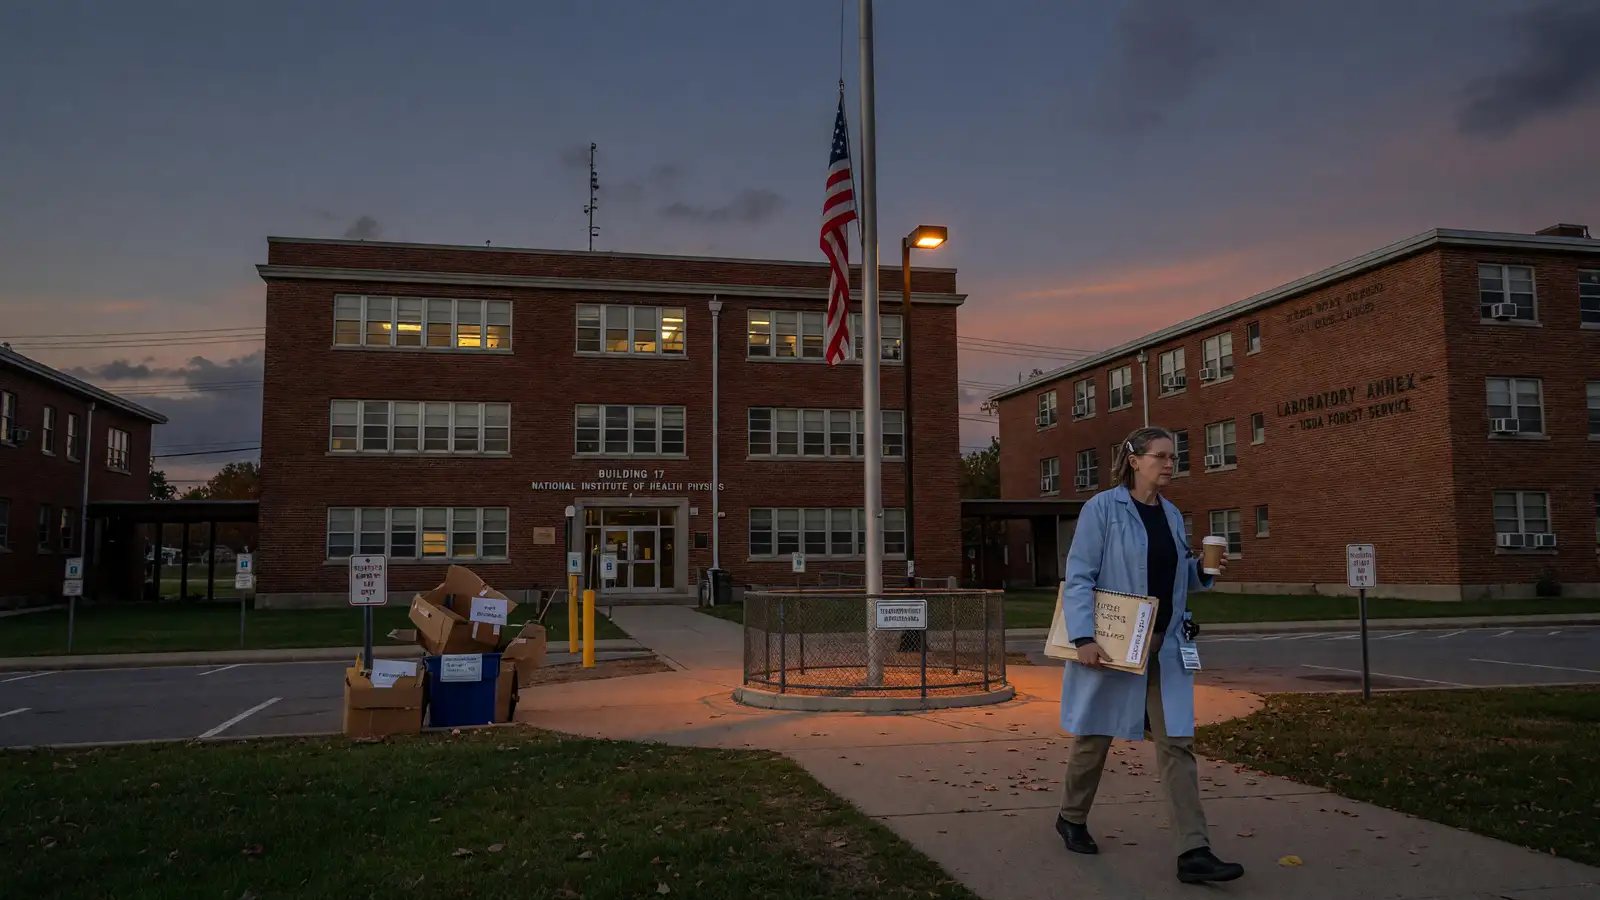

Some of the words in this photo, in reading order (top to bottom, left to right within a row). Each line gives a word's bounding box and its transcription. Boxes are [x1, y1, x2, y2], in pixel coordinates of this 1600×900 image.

[1277, 386, 1356, 417] LABORATORY
[1367, 373, 1416, 399] ANNEX
[1300, 415, 1324, 430] USDA
[1328, 408, 1363, 425] FOREST
[1369, 398, 1412, 418] SERVICE
[598, 469, 648, 479] BUILDING
[654, 469, 665, 479] 17
[531, 482, 576, 490] NATIONAL
[581, 482, 628, 491] INSTITUTE
[633, 482, 645, 490] OF
[650, 482, 683, 491] HEALTH
[687, 482, 725, 491] PHYSIS
